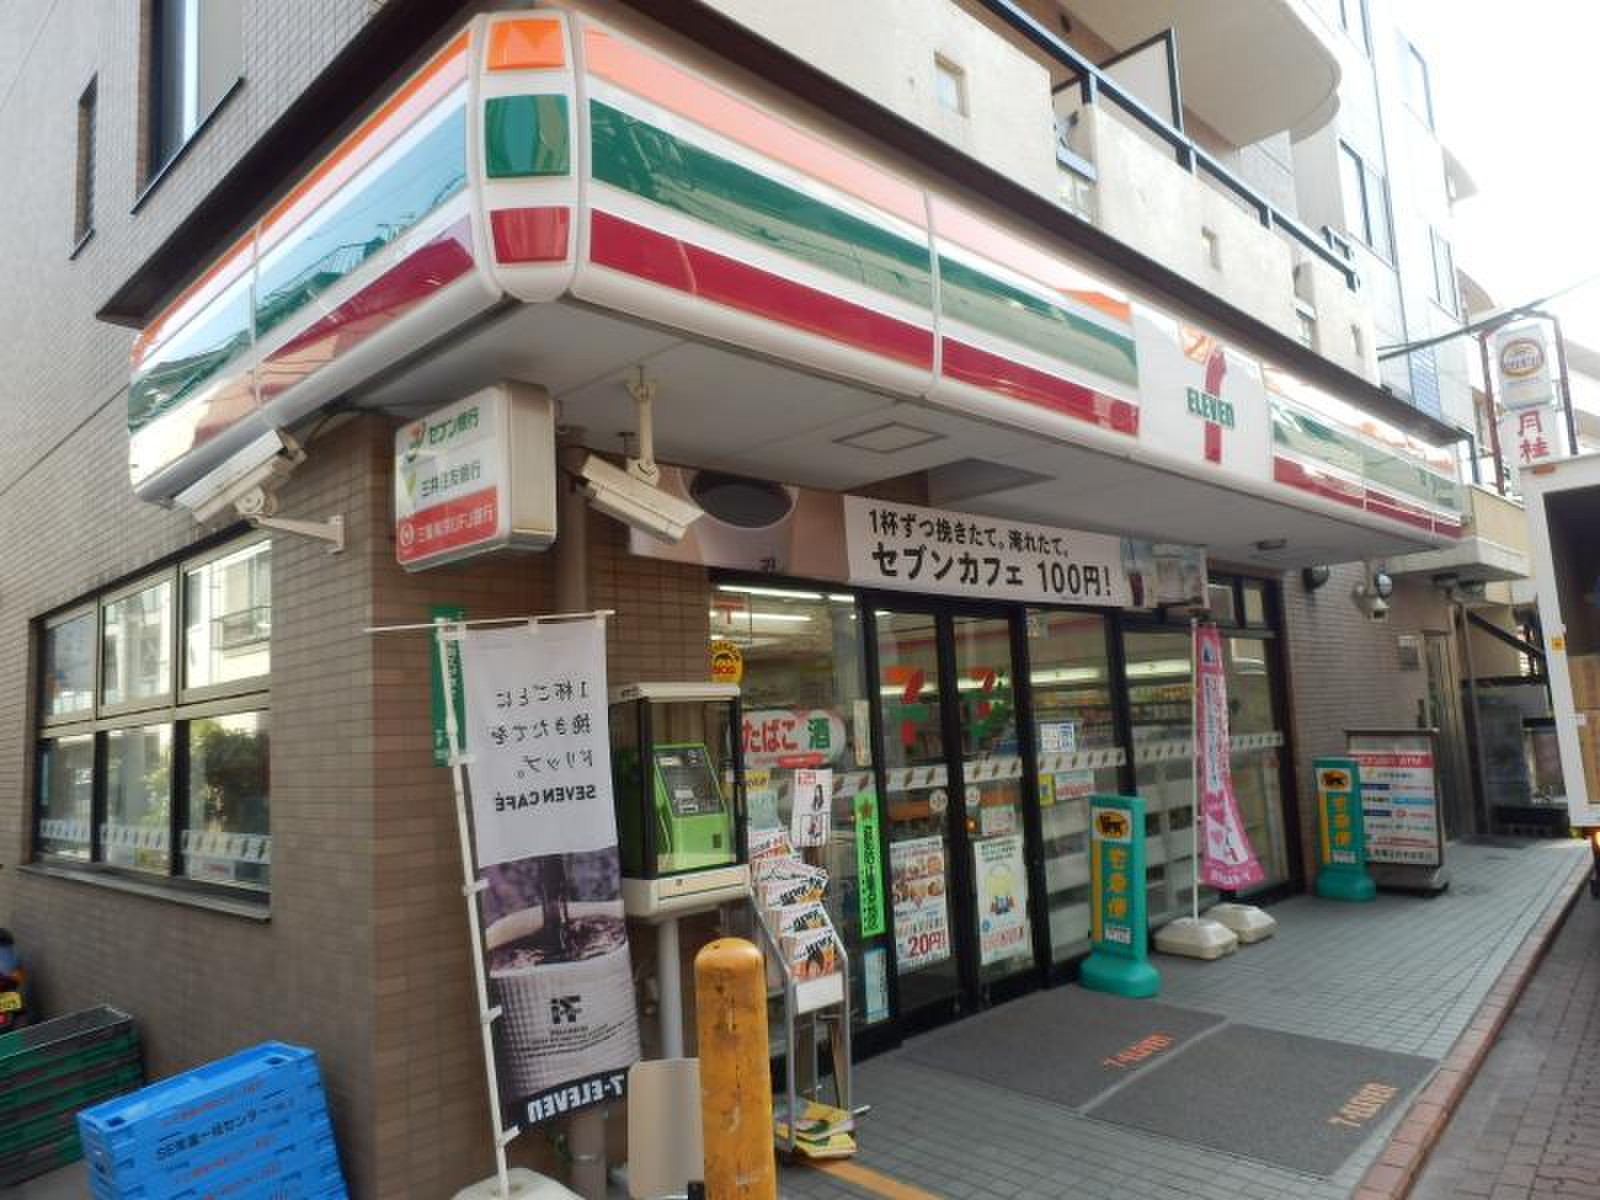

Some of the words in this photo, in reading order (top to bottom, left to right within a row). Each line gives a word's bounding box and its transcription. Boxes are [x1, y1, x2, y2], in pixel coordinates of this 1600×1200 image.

[872, 542, 1024, 587] セブンカフェ
[1037, 560, 1111, 596] 100円!
[741, 718, 799, 752] たばこ
[807, 717, 831, 749] 酒
